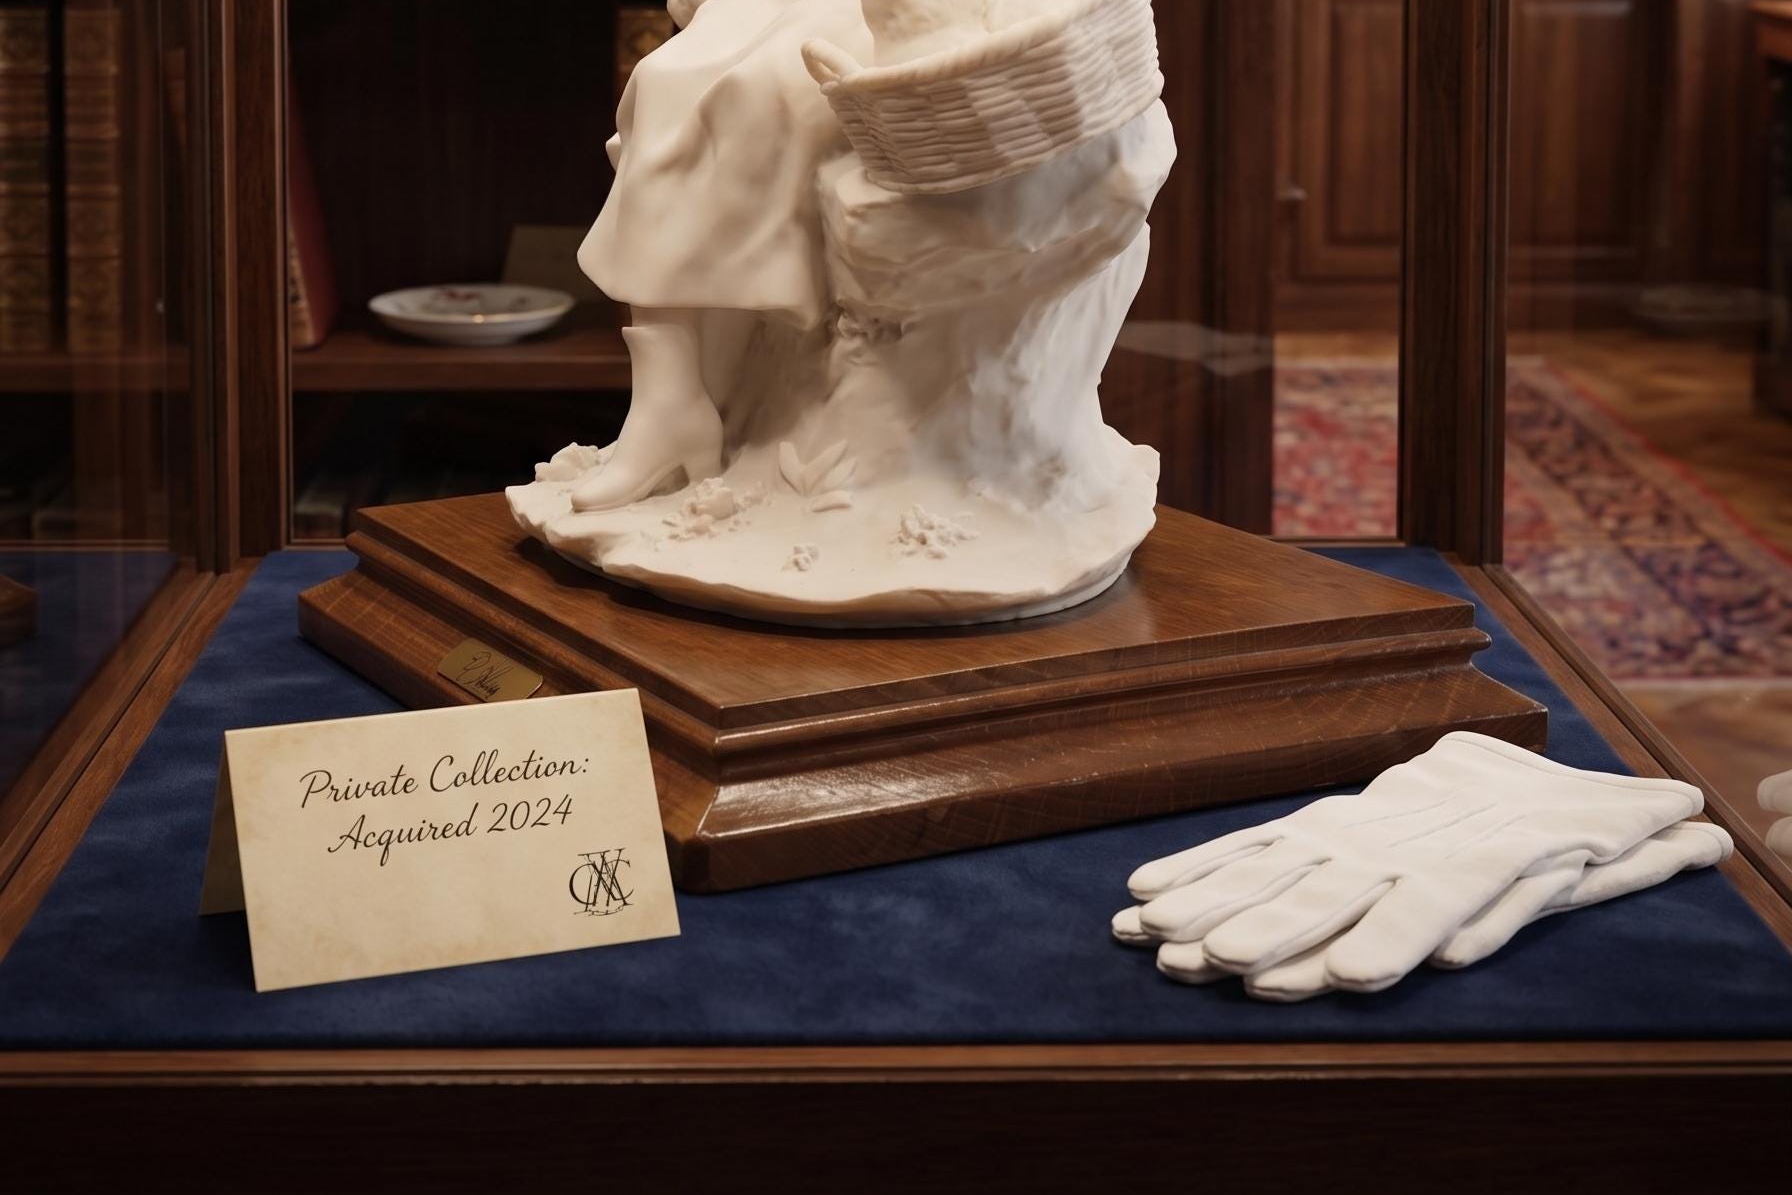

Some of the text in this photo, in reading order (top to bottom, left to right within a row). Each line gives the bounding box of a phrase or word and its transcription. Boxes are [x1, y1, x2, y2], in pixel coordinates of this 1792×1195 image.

[299, 748, 591, 809] Private Collection:
[327, 793, 573, 868] Acquired 2024
